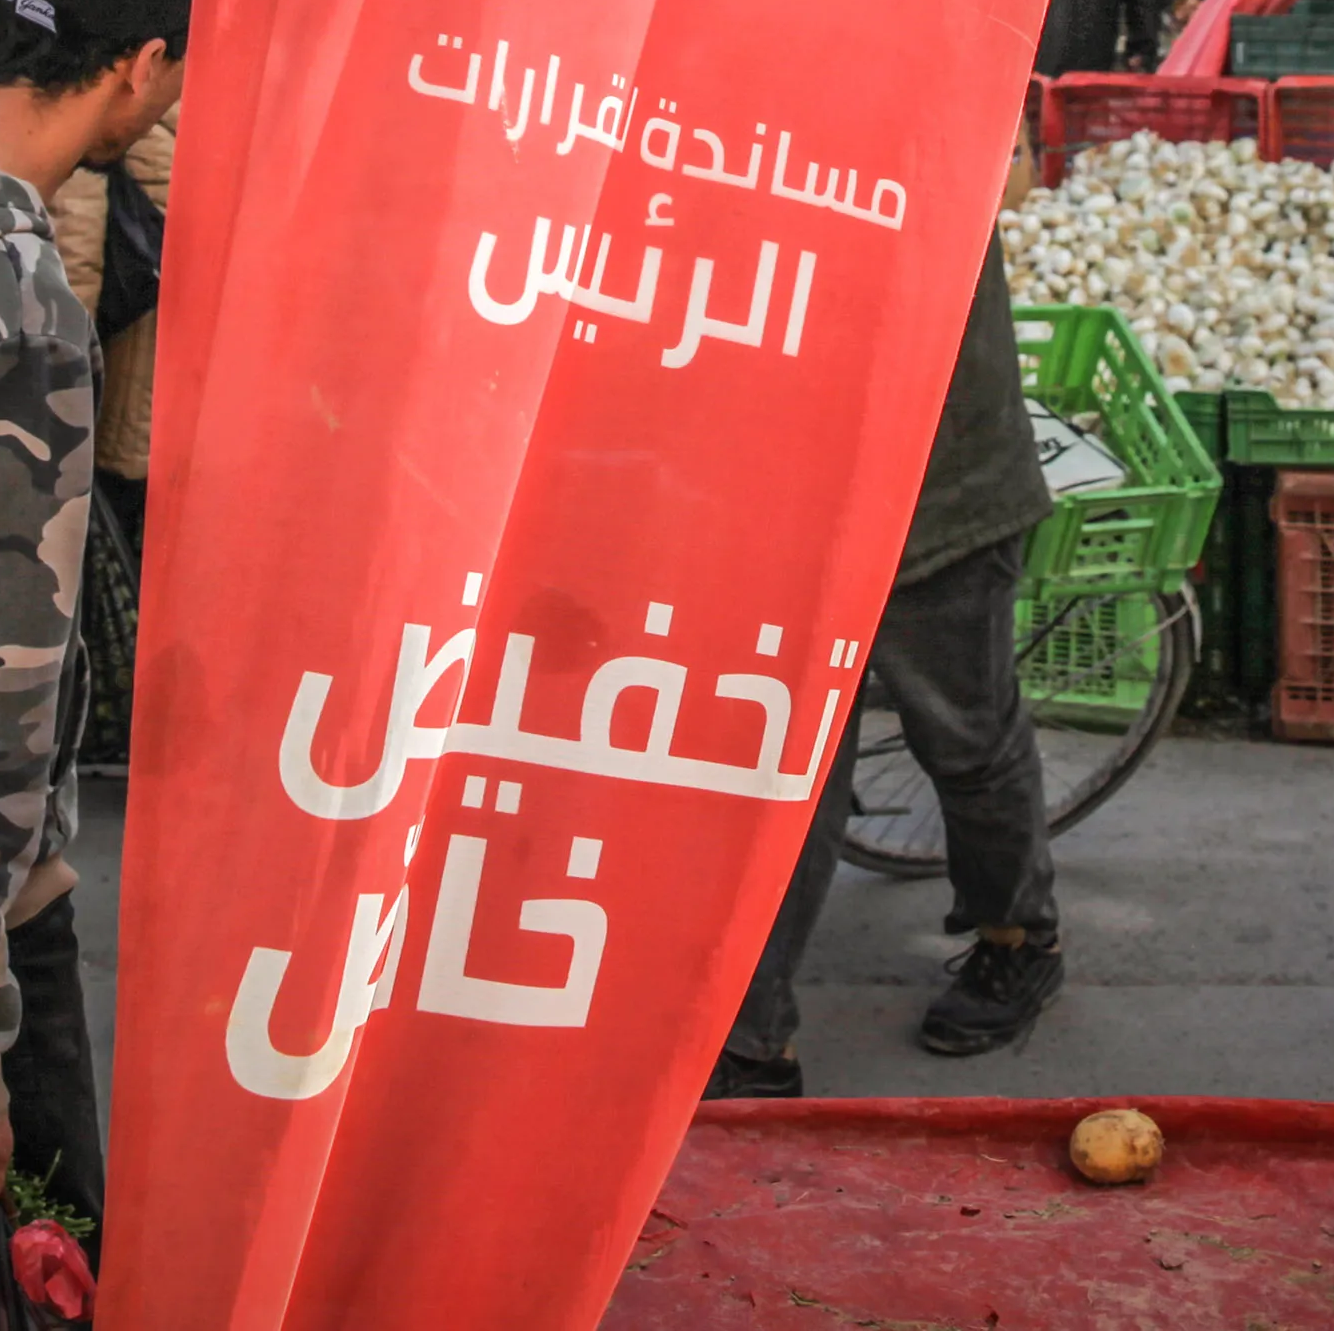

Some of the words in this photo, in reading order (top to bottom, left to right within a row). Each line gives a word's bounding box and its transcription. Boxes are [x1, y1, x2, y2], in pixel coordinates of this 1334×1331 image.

[407, 33, 639, 156] لقرارات
[639, 97, 907, 230] مساندة
[468, 192, 817, 369] الرئيس
[278, 571, 859, 820] تخفيض
